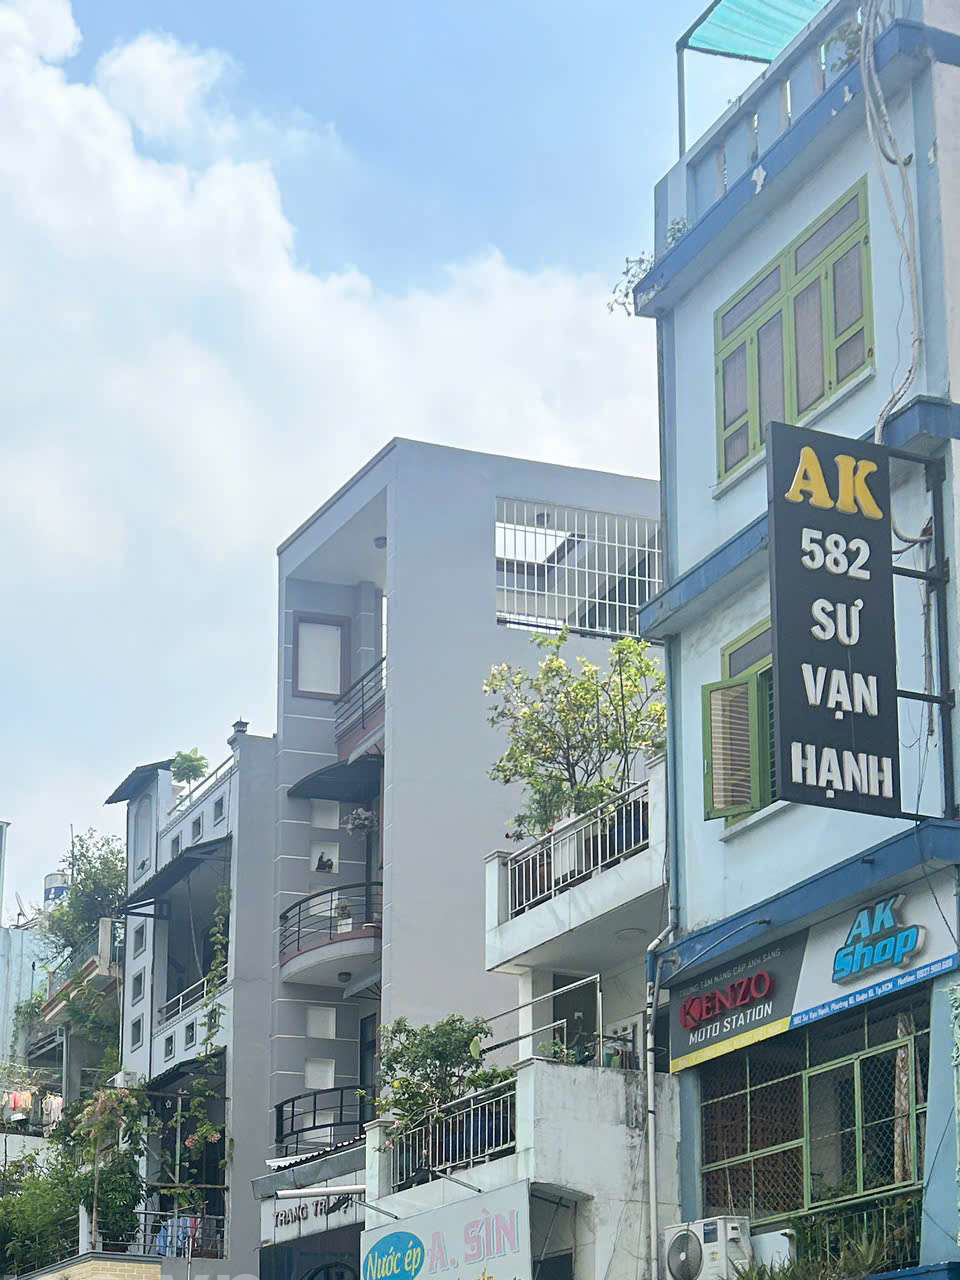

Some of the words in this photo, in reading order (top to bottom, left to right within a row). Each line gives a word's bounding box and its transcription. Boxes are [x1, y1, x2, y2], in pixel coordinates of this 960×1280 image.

[784, 445, 884, 520] AK
[801, 527, 872, 581] 582
[810, 597, 864, 647] SƯ
[801, 662, 879, 720] VẠN
[792, 741, 893, 799] HẠNH
[845, 894, 903, 944] AK
[832, 925, 924, 983] Shop
[679, 970, 775, 1031] KENZO
[688, 1022, 721, 1046] MOTO
[723, 1001, 773, 1033] STATION
[273, 1203, 308, 1228] TRANG
[367, 1246, 401, 1280] Nước
[404, 1240, 421, 1277] ép
